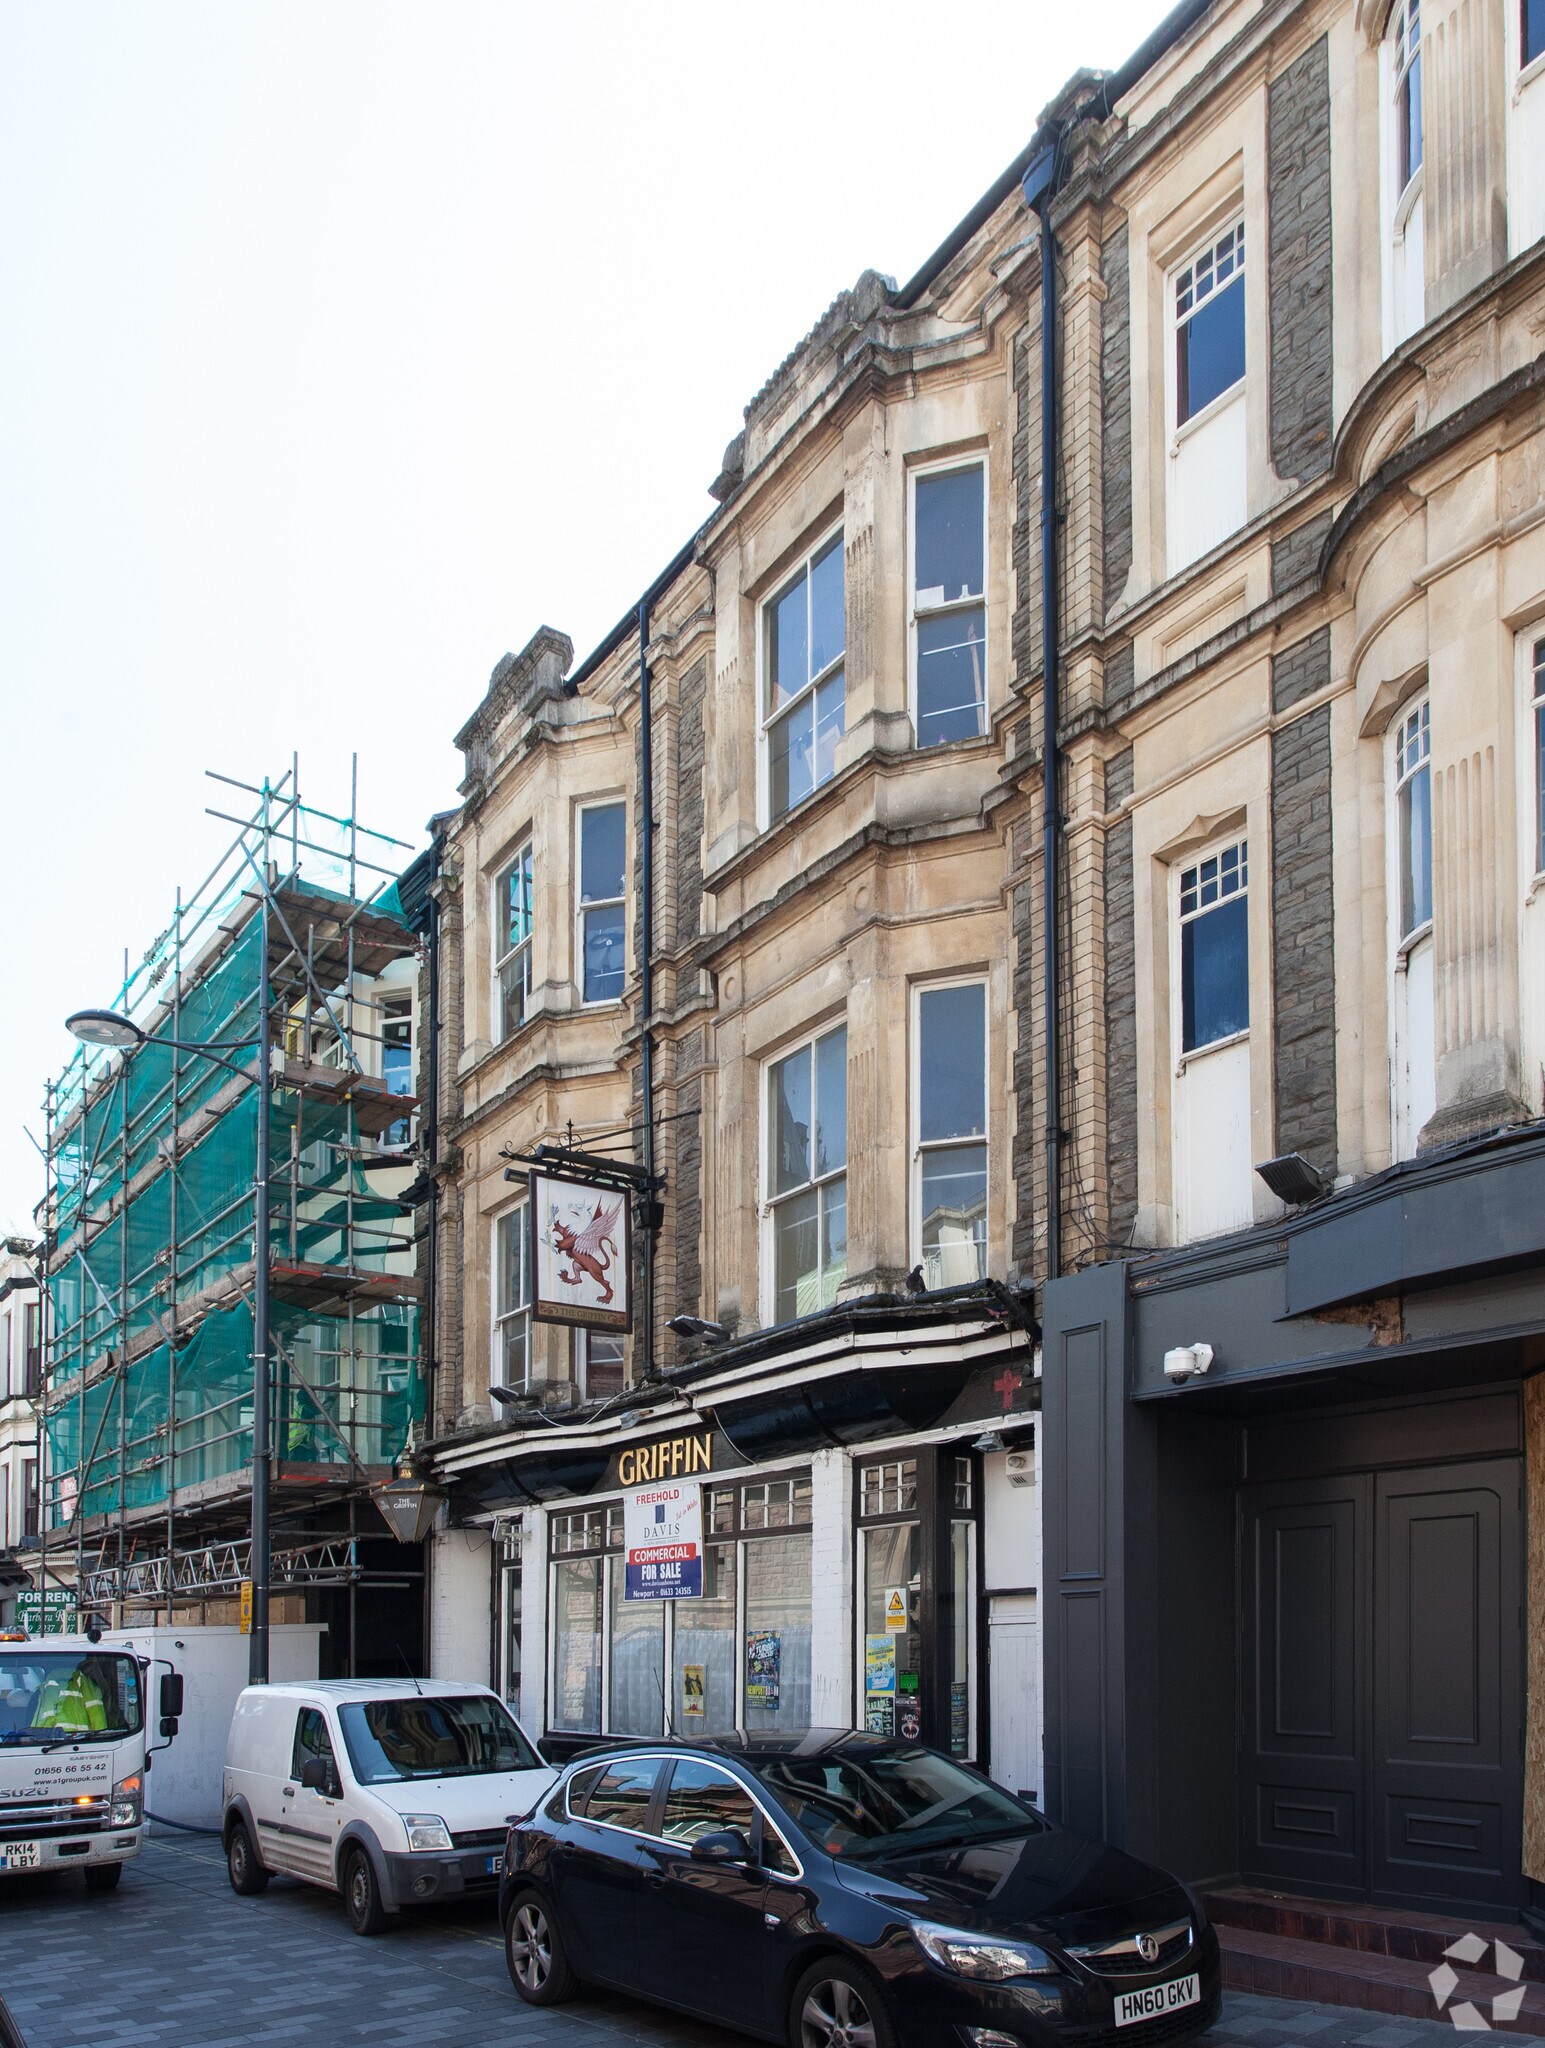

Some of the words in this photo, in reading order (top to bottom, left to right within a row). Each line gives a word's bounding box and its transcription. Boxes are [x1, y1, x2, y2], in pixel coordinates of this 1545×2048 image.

[560, 1308, 576, 1317] THE
[577, 1311, 607, 1320] GRIFFIN
[618, 1433, 712, 1486] GRIFFIN
[636, 1489, 680, 1506] FREEHOLD
[643, 1523, 680, 1538] DAVIS
[634, 1546, 690, 1563] COMMERCIAL
[641, 1564, 657, 1580] FOR
[660, 1562, 682, 1579] SALE
[17, 1592, 42, 1603] FOR
[633, 1589, 655, 1599] Newport
[660, 1588, 674, 1597] 01633
[675, 1586, 692, 1596] 243515
[34, 1765, 62, 1776] 01656
[65, 1765, 77, 1773] 66
[80, 1764, 92, 1772] 55
[94, 1763, 107, 1771] 42
[34, 1774, 107, 1785] www.a1groupuk.com
[5, 1842, 35, 1855] RK14
[10, 1855, 36, 1868] LBY
[1122, 1988, 1165, 2019] HN60
[1167, 1977, 1194, 2006] GKV
